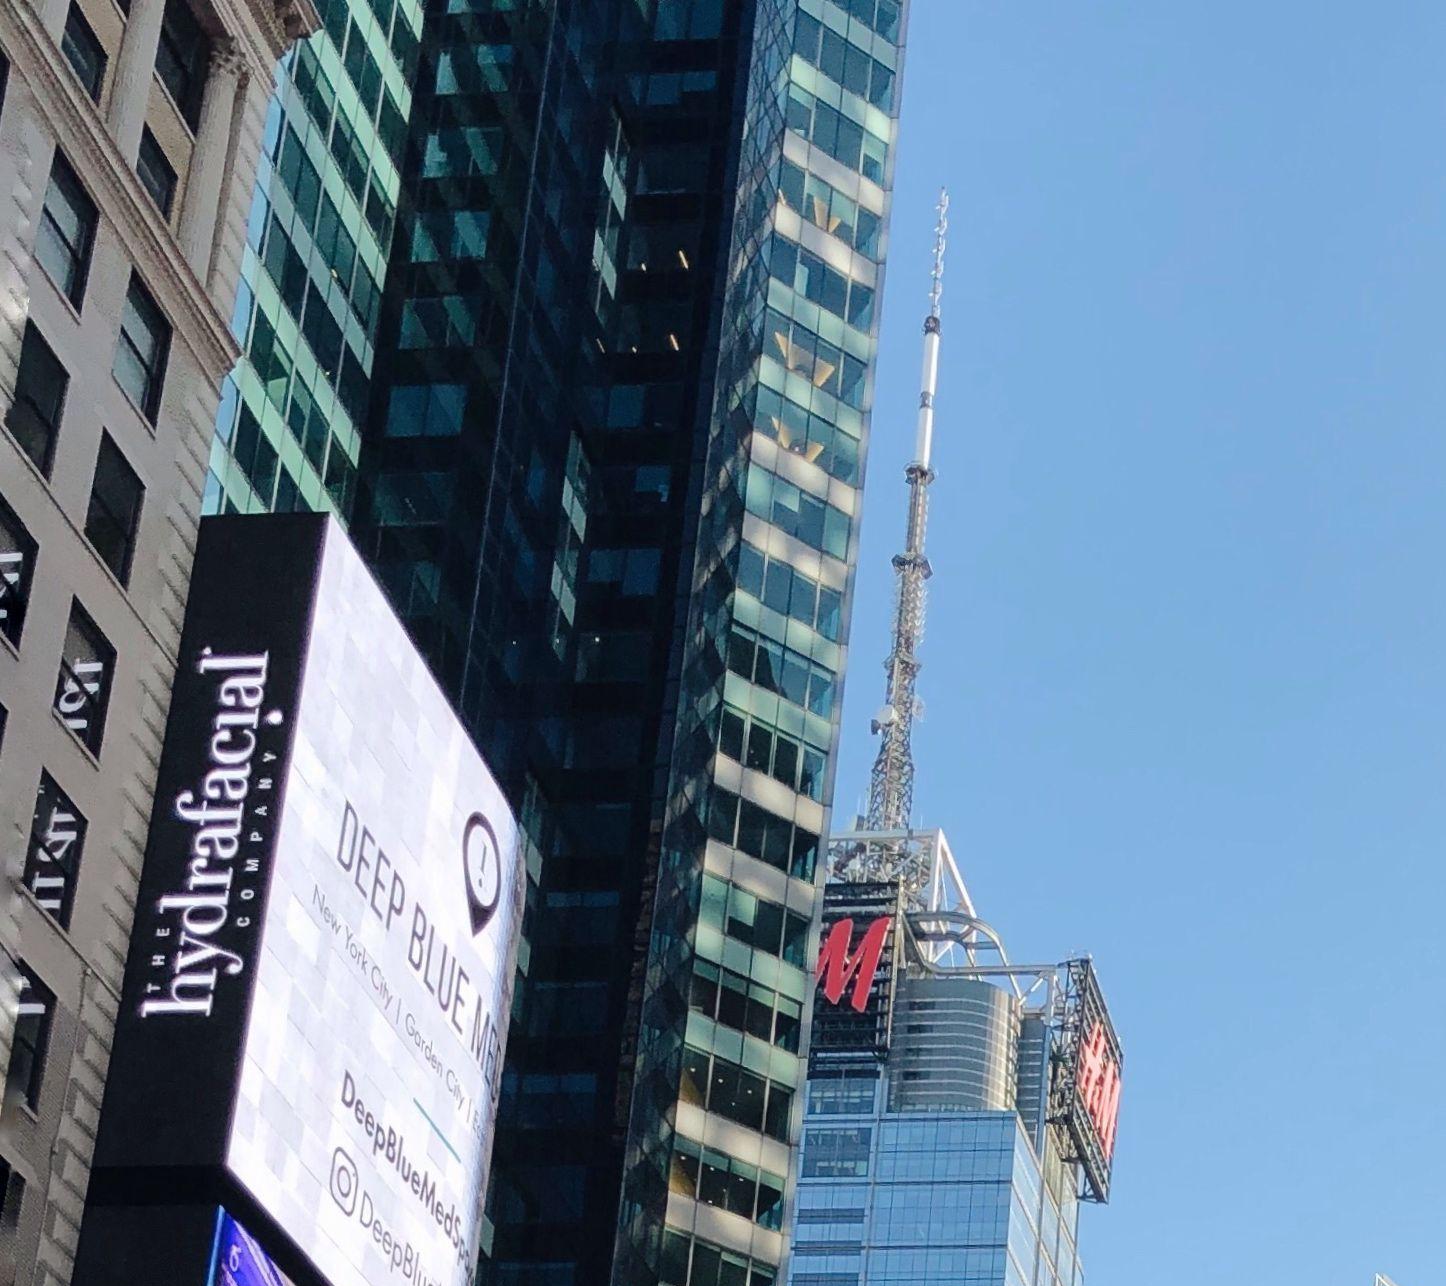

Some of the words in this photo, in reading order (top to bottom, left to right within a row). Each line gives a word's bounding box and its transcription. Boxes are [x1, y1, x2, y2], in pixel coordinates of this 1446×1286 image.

[236, 751, 277, 929] COMPANY
[337, 800, 405, 931] DEEP
[408, 902, 469, 1035] BLUE
[313, 884, 341, 935] New
[345, 926, 367, 976] York
[371, 966, 393, 1010] City
[405, 1013, 443, 1079] Garden
